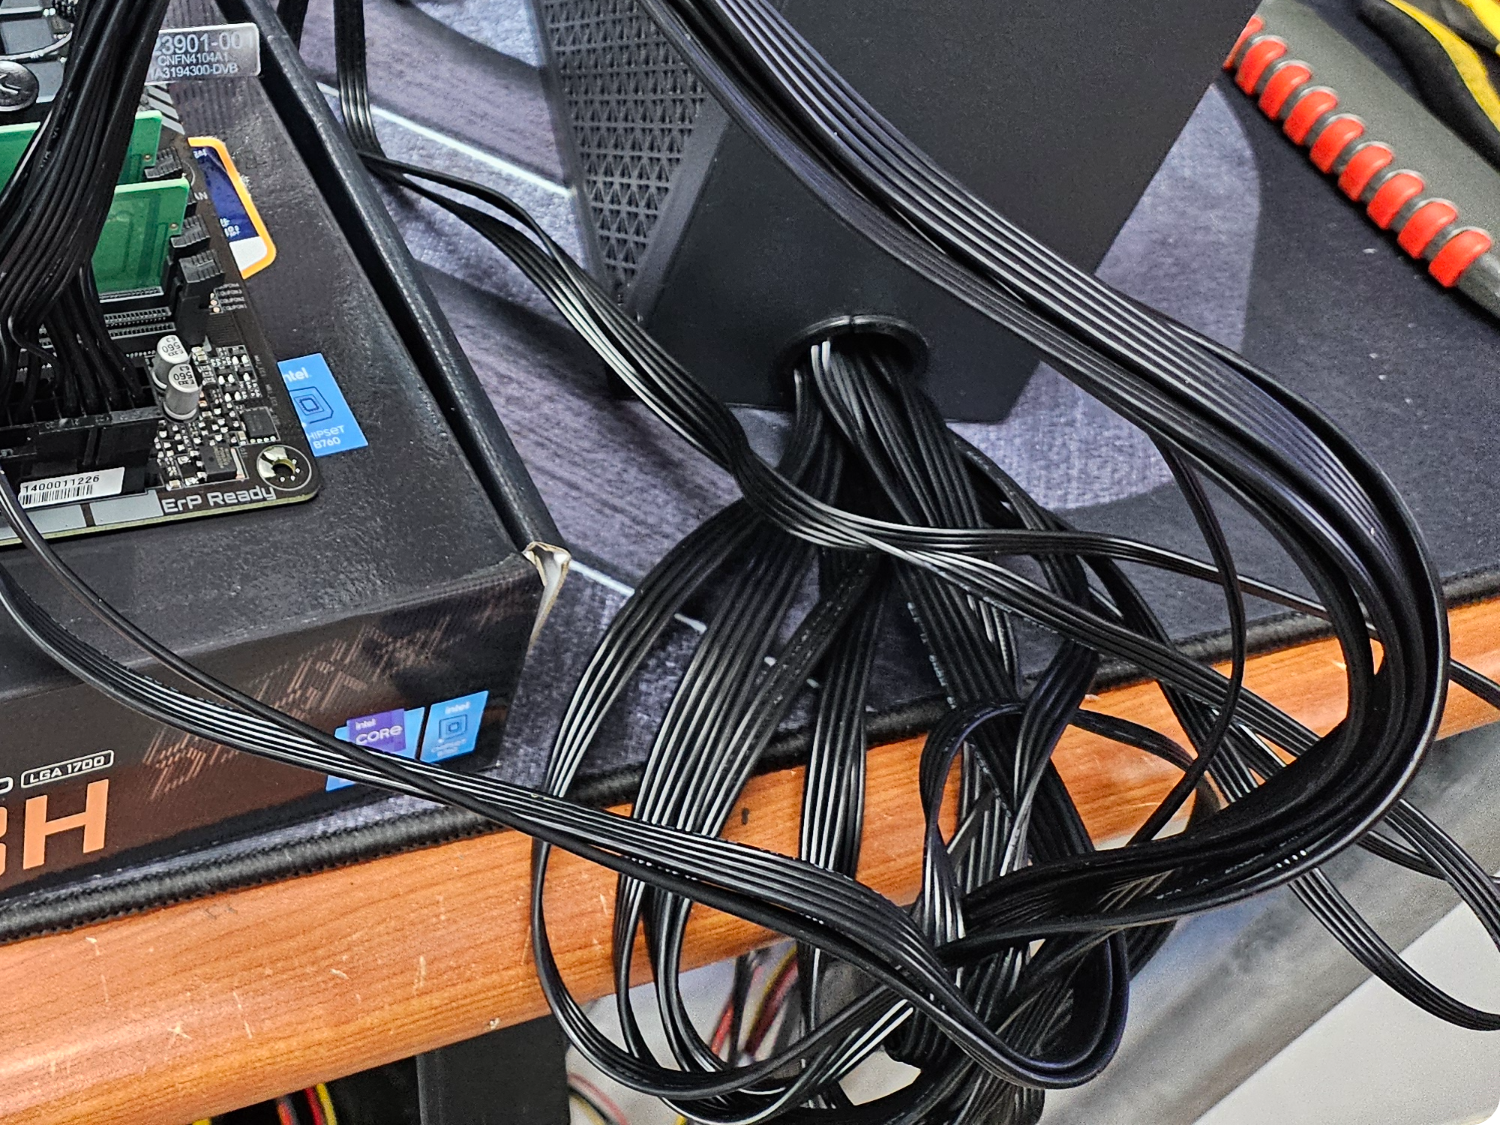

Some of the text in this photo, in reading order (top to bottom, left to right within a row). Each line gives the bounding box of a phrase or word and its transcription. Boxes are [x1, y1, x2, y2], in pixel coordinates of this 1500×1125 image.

[282, 366, 310, 383] ntel
[313, 437, 341, 450] B760
[22, 474, 101, 494] 1400011226
[162, 485, 277, 514] ErP Ready
[355, 718, 377, 731] intel
[28, 756, 106, 784] LGA 1700
